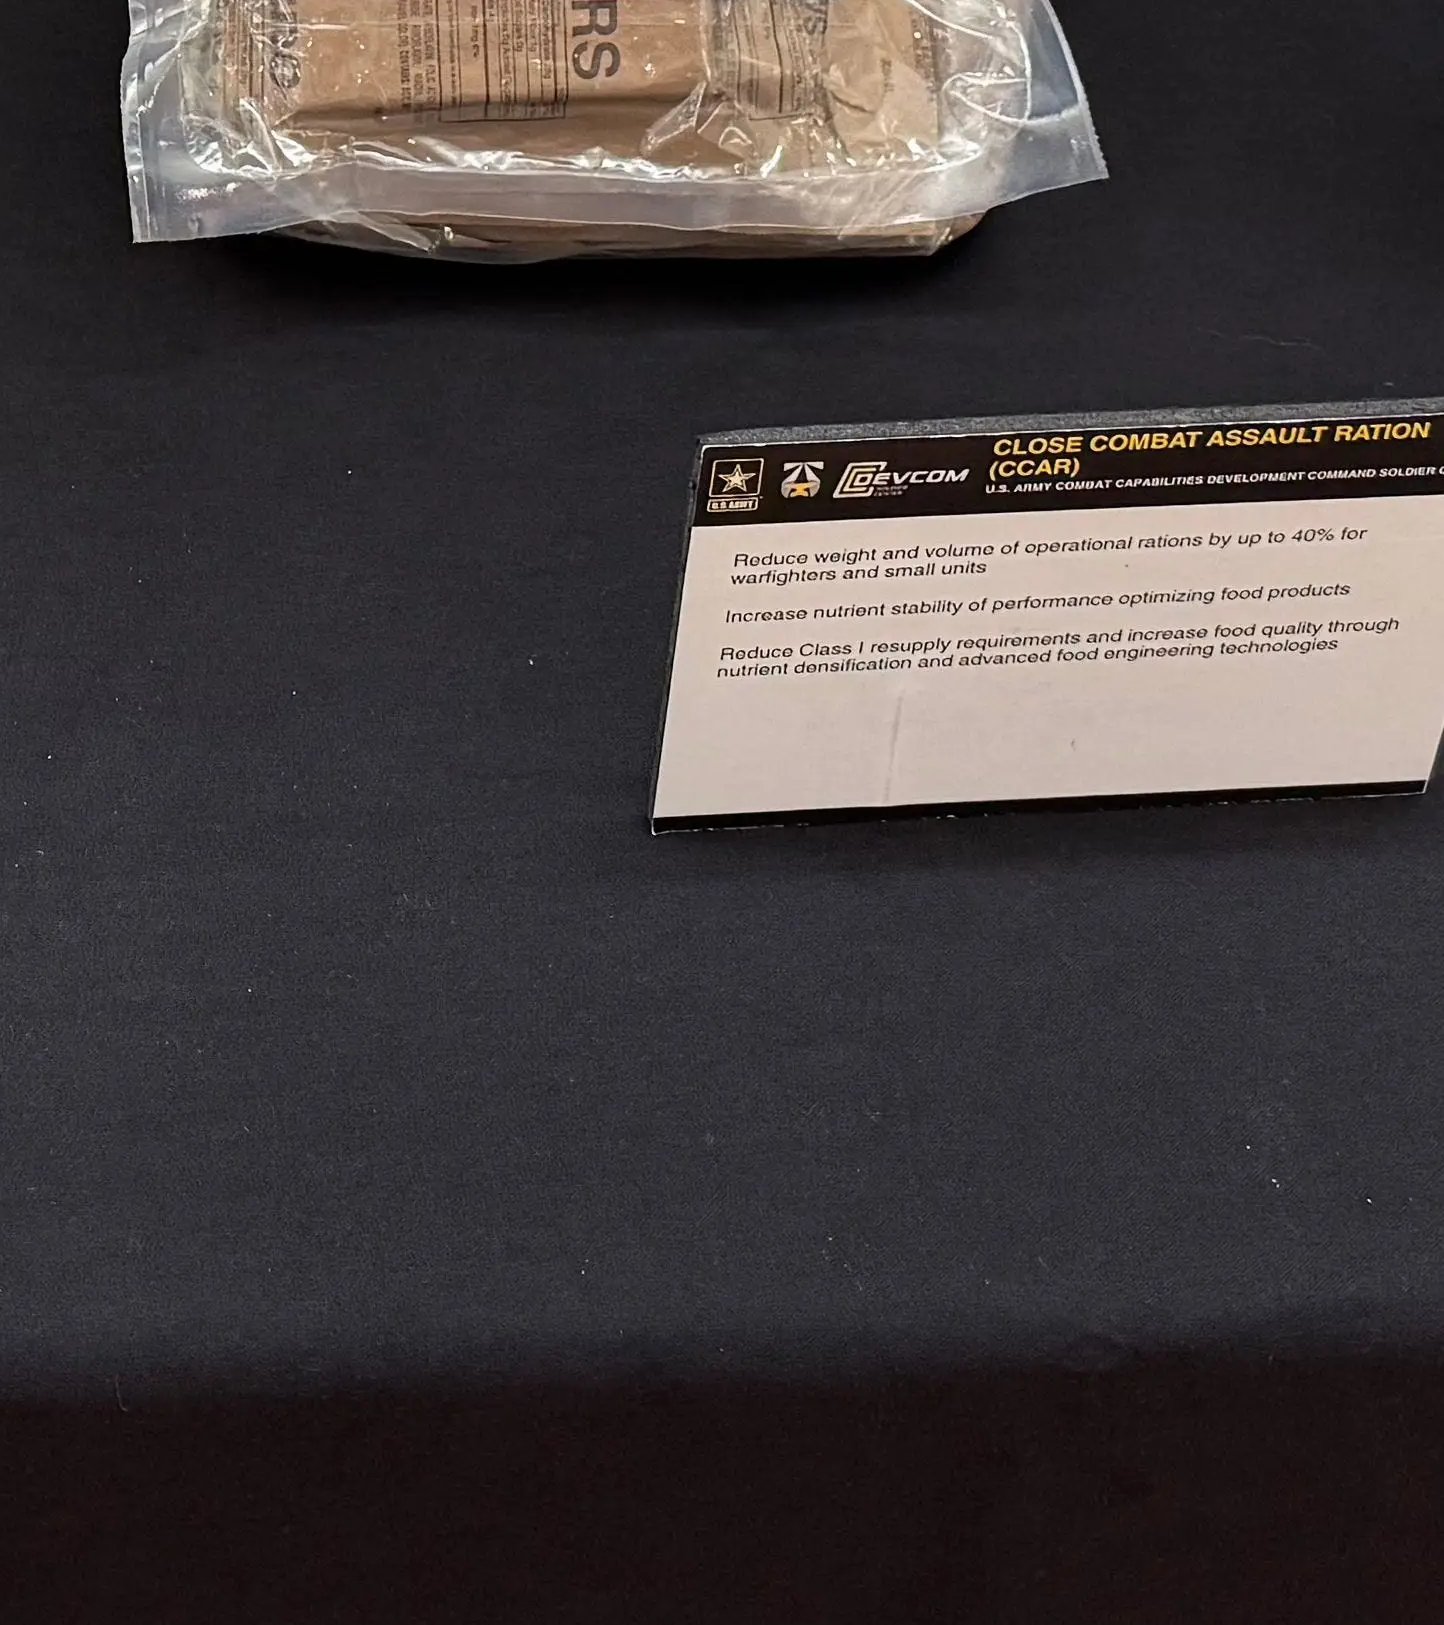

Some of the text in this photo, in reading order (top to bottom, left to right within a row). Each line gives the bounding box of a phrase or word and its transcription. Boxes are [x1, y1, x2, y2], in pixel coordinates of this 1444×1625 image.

[992, 421, 1432, 457] CLOSE COMBAT ASSAULT RATION
[985, 483, 1011, 494] U.S.
[1013, 481, 1052, 493] ARMY
[1055, 478, 1113, 492] COMBAT
[1206, 471, 1306, 485] DEVELOPMENT
[1307, 467, 1377, 481] COMMAND
[1378, 466, 1436, 478] SOLDIER
[988, 457, 1081, 482] (CCAR)
[733, 526, 1368, 568] Reduce weight and volume of operational rations by up to 40% for
[730, 560, 988, 587] warfighters and small units
[725, 582, 1352, 624] Increase nutrient stability of performance optimizing food products
